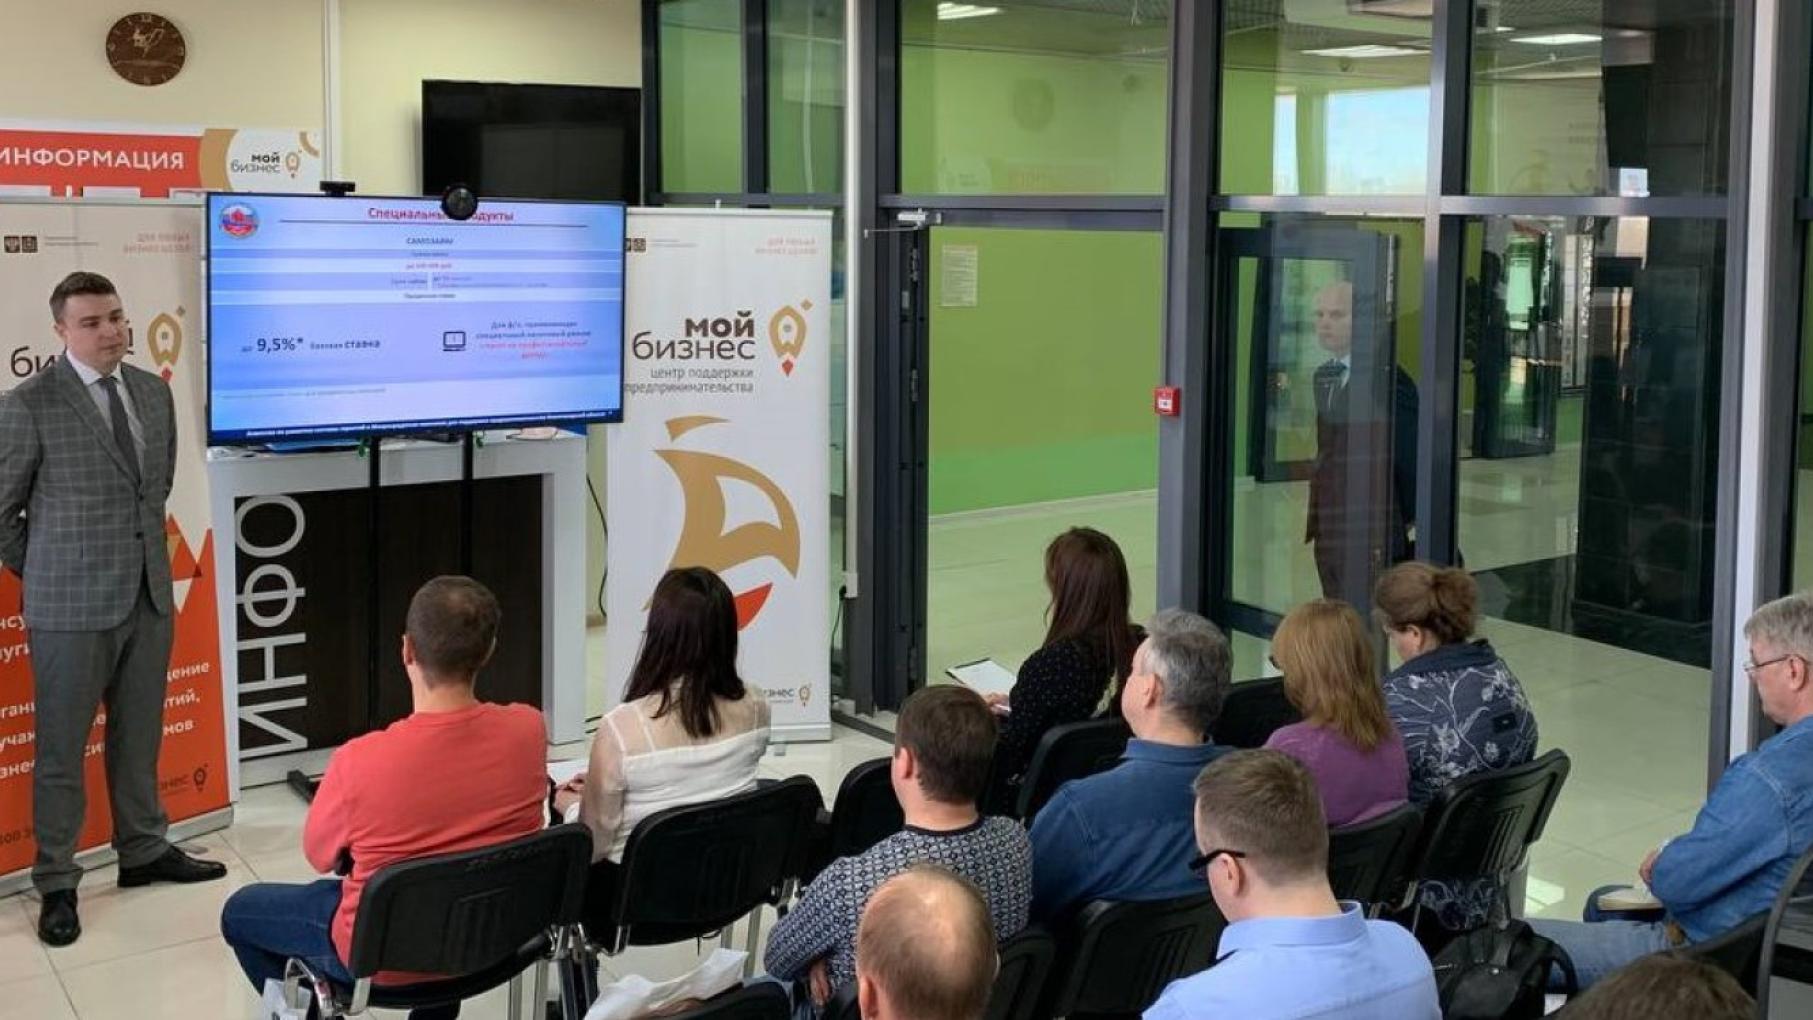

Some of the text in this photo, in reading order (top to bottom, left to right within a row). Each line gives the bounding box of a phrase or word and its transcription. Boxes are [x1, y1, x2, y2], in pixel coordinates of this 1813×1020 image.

[0, 147, 184, 170] ИНФОРМАЦИЯ
[231, 159, 281, 173] бизнес
[251, 151, 280, 163] мой
[368, 208, 447, 221] Специальны
[685, 310, 755, 338] мой
[632, 331, 756, 360] бизнес
[651, 367, 754, 380] центр поддержки
[235, 494, 308, 760] ИНФО
